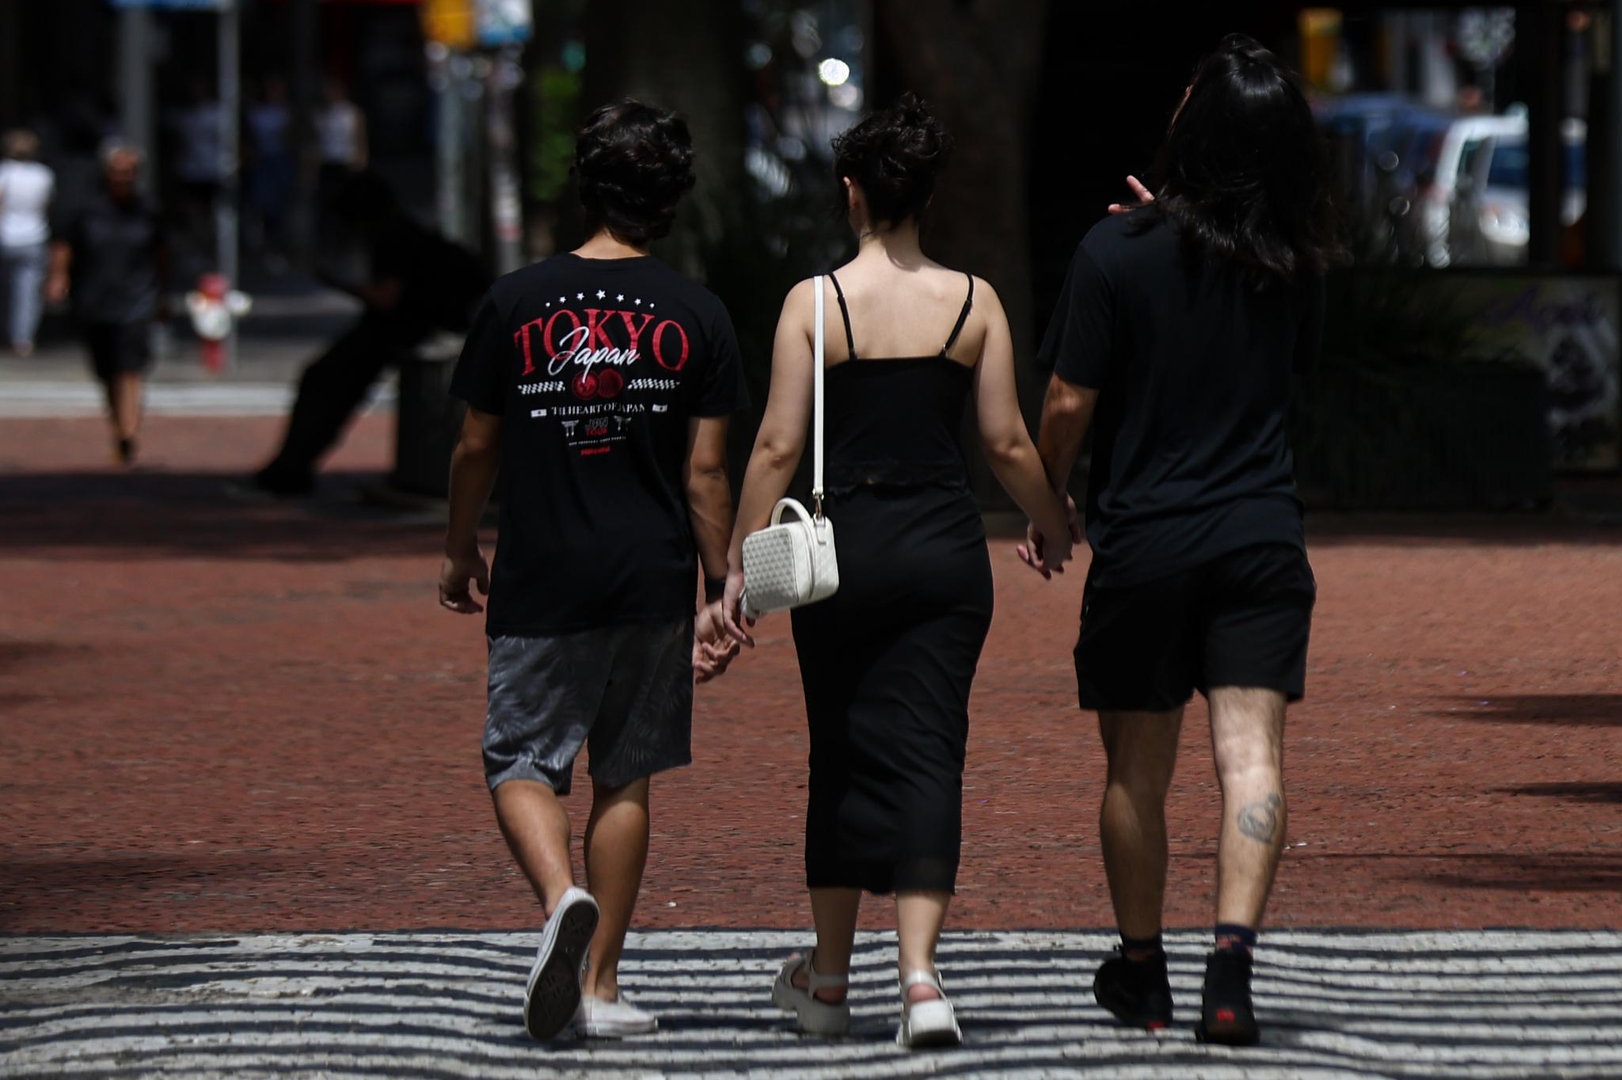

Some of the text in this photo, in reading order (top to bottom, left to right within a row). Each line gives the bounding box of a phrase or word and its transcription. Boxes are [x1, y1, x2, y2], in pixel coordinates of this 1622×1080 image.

[514, 308, 690, 376] TOKYO
[547, 326, 640, 383] Japan
[568, 404, 601, 415] HEART
